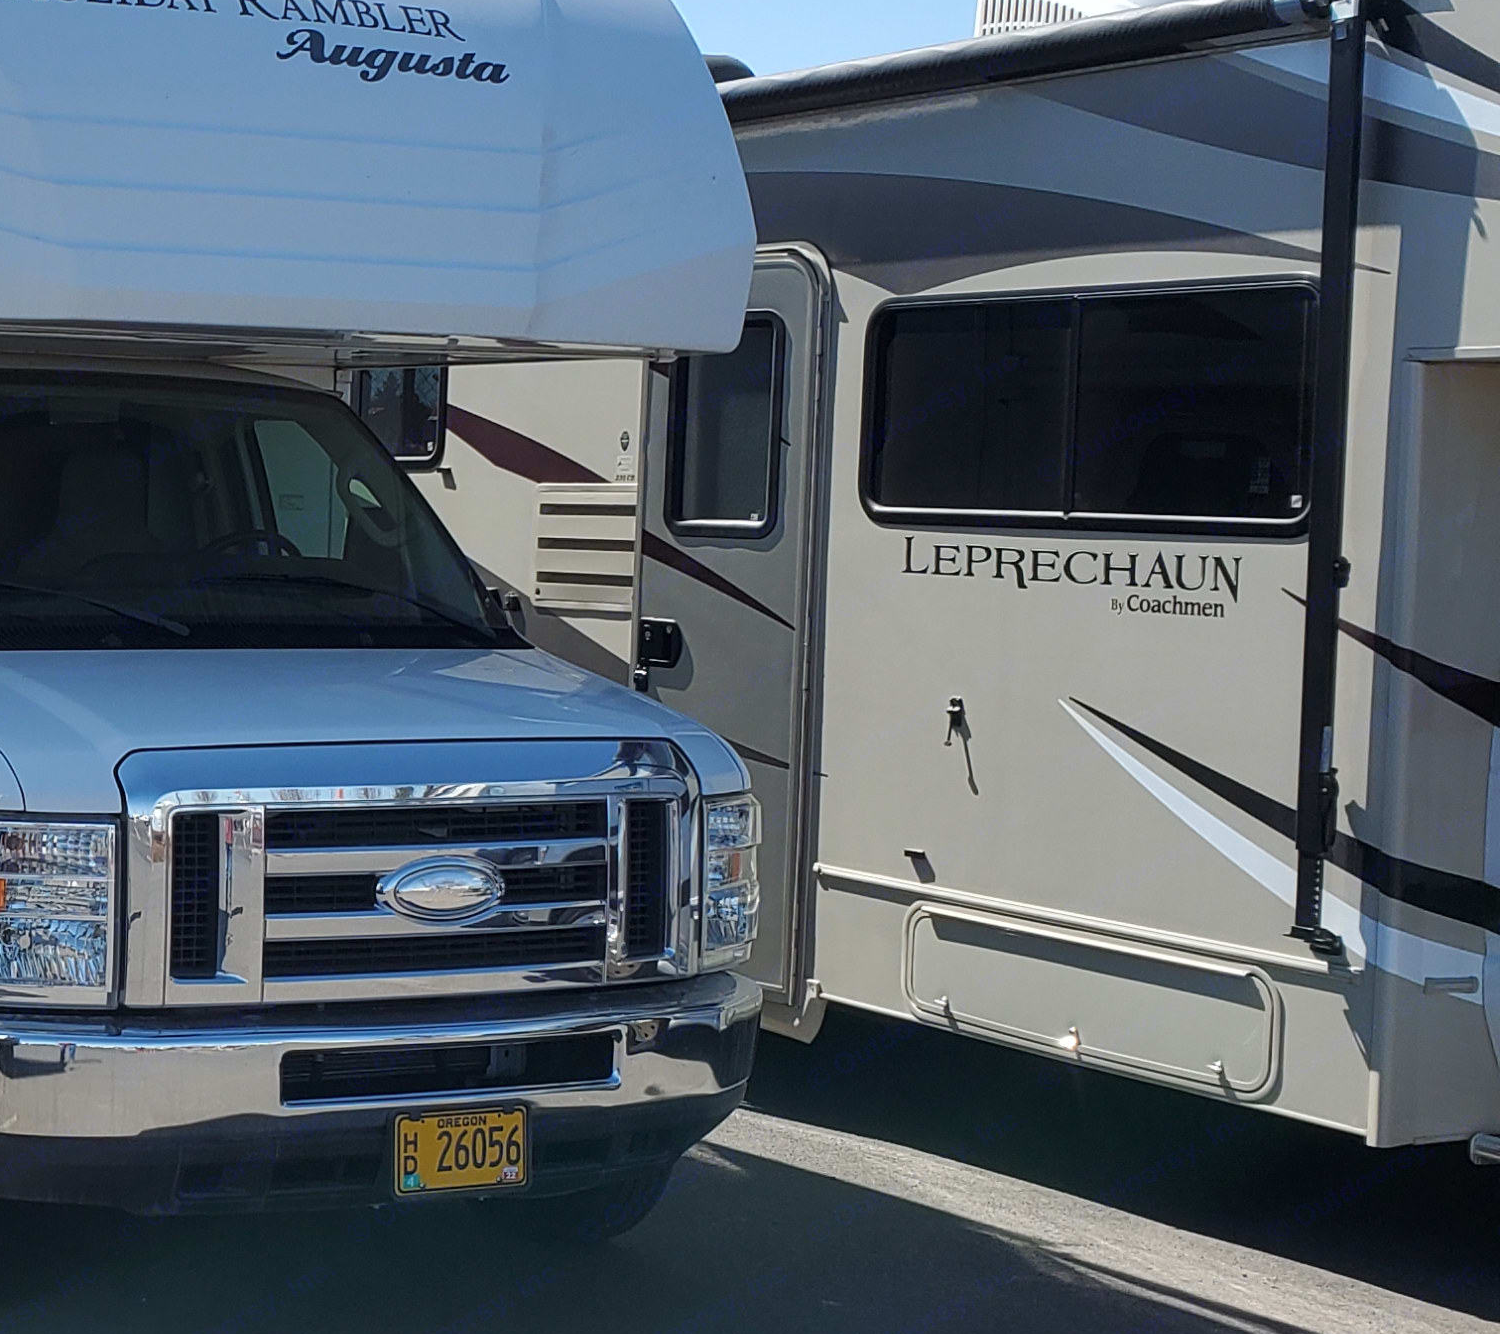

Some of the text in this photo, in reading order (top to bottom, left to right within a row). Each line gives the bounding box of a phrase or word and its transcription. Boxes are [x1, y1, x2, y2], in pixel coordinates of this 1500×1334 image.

[276, 28, 510, 84] Augusta
[901, 535, 1243, 604] LEPRECHAUN
[1110, 594, 1226, 619] By Coachmen
[436, 1115, 487, 1130] OREGON
[436, 1124, 521, 1173] 26056
